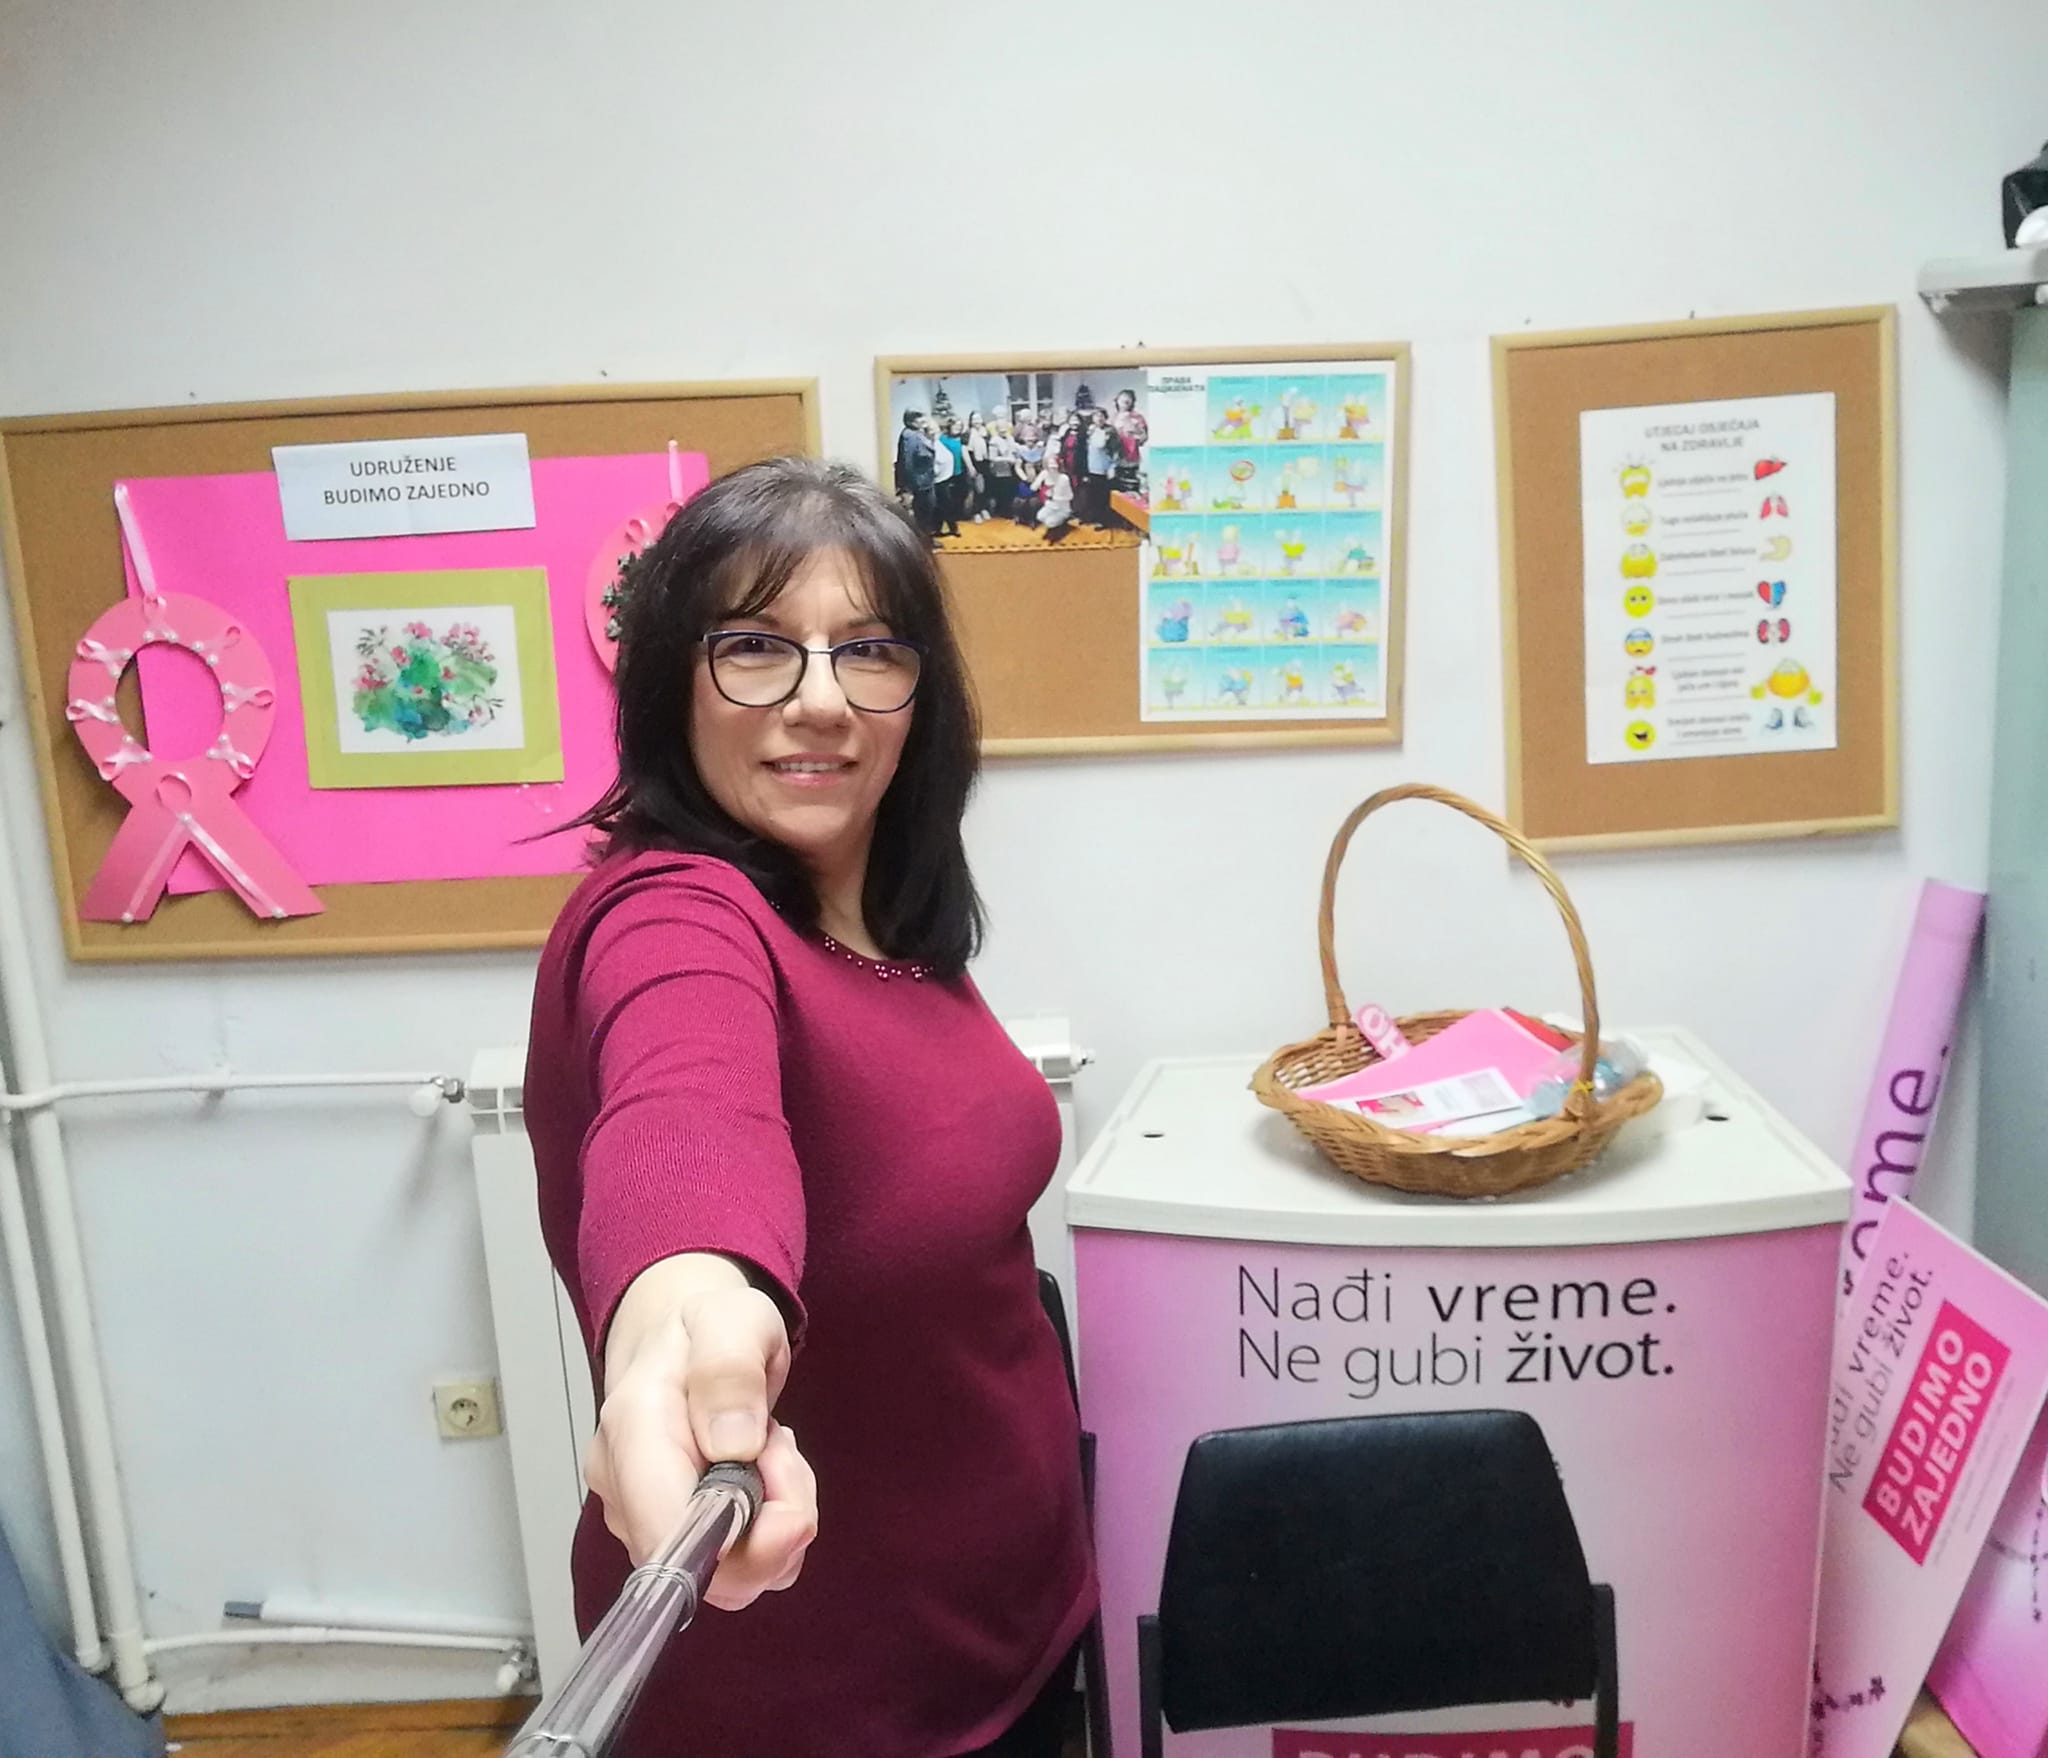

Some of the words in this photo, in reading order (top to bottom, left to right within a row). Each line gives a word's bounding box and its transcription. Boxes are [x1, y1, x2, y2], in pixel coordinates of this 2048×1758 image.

[350, 455, 457, 477] UDRUŽENJE
[1661, 441, 1678, 452] NA
[324, 486, 401, 505] BUDIMO
[406, 481, 490, 501] ZAJEDNO
[1238, 1264, 1393, 1323] Nađi
[1427, 1275, 1677, 1323] vreme.
[1849, 1252, 1910, 1374] vreme.
[1239, 1327, 1321, 1384] Ne
[1344, 1331, 1483, 1400] gubi
[1505, 1330, 1675, 1384] život.
[1828, 1443, 1863, 1495] Ne
[1854, 1355, 1894, 1445] gubi
[1882, 1269, 1934, 1359] život.
[1876, 1329, 1964, 1518] BUDIMO
[1900, 1351, 1993, 1547] ZAJEDNO
